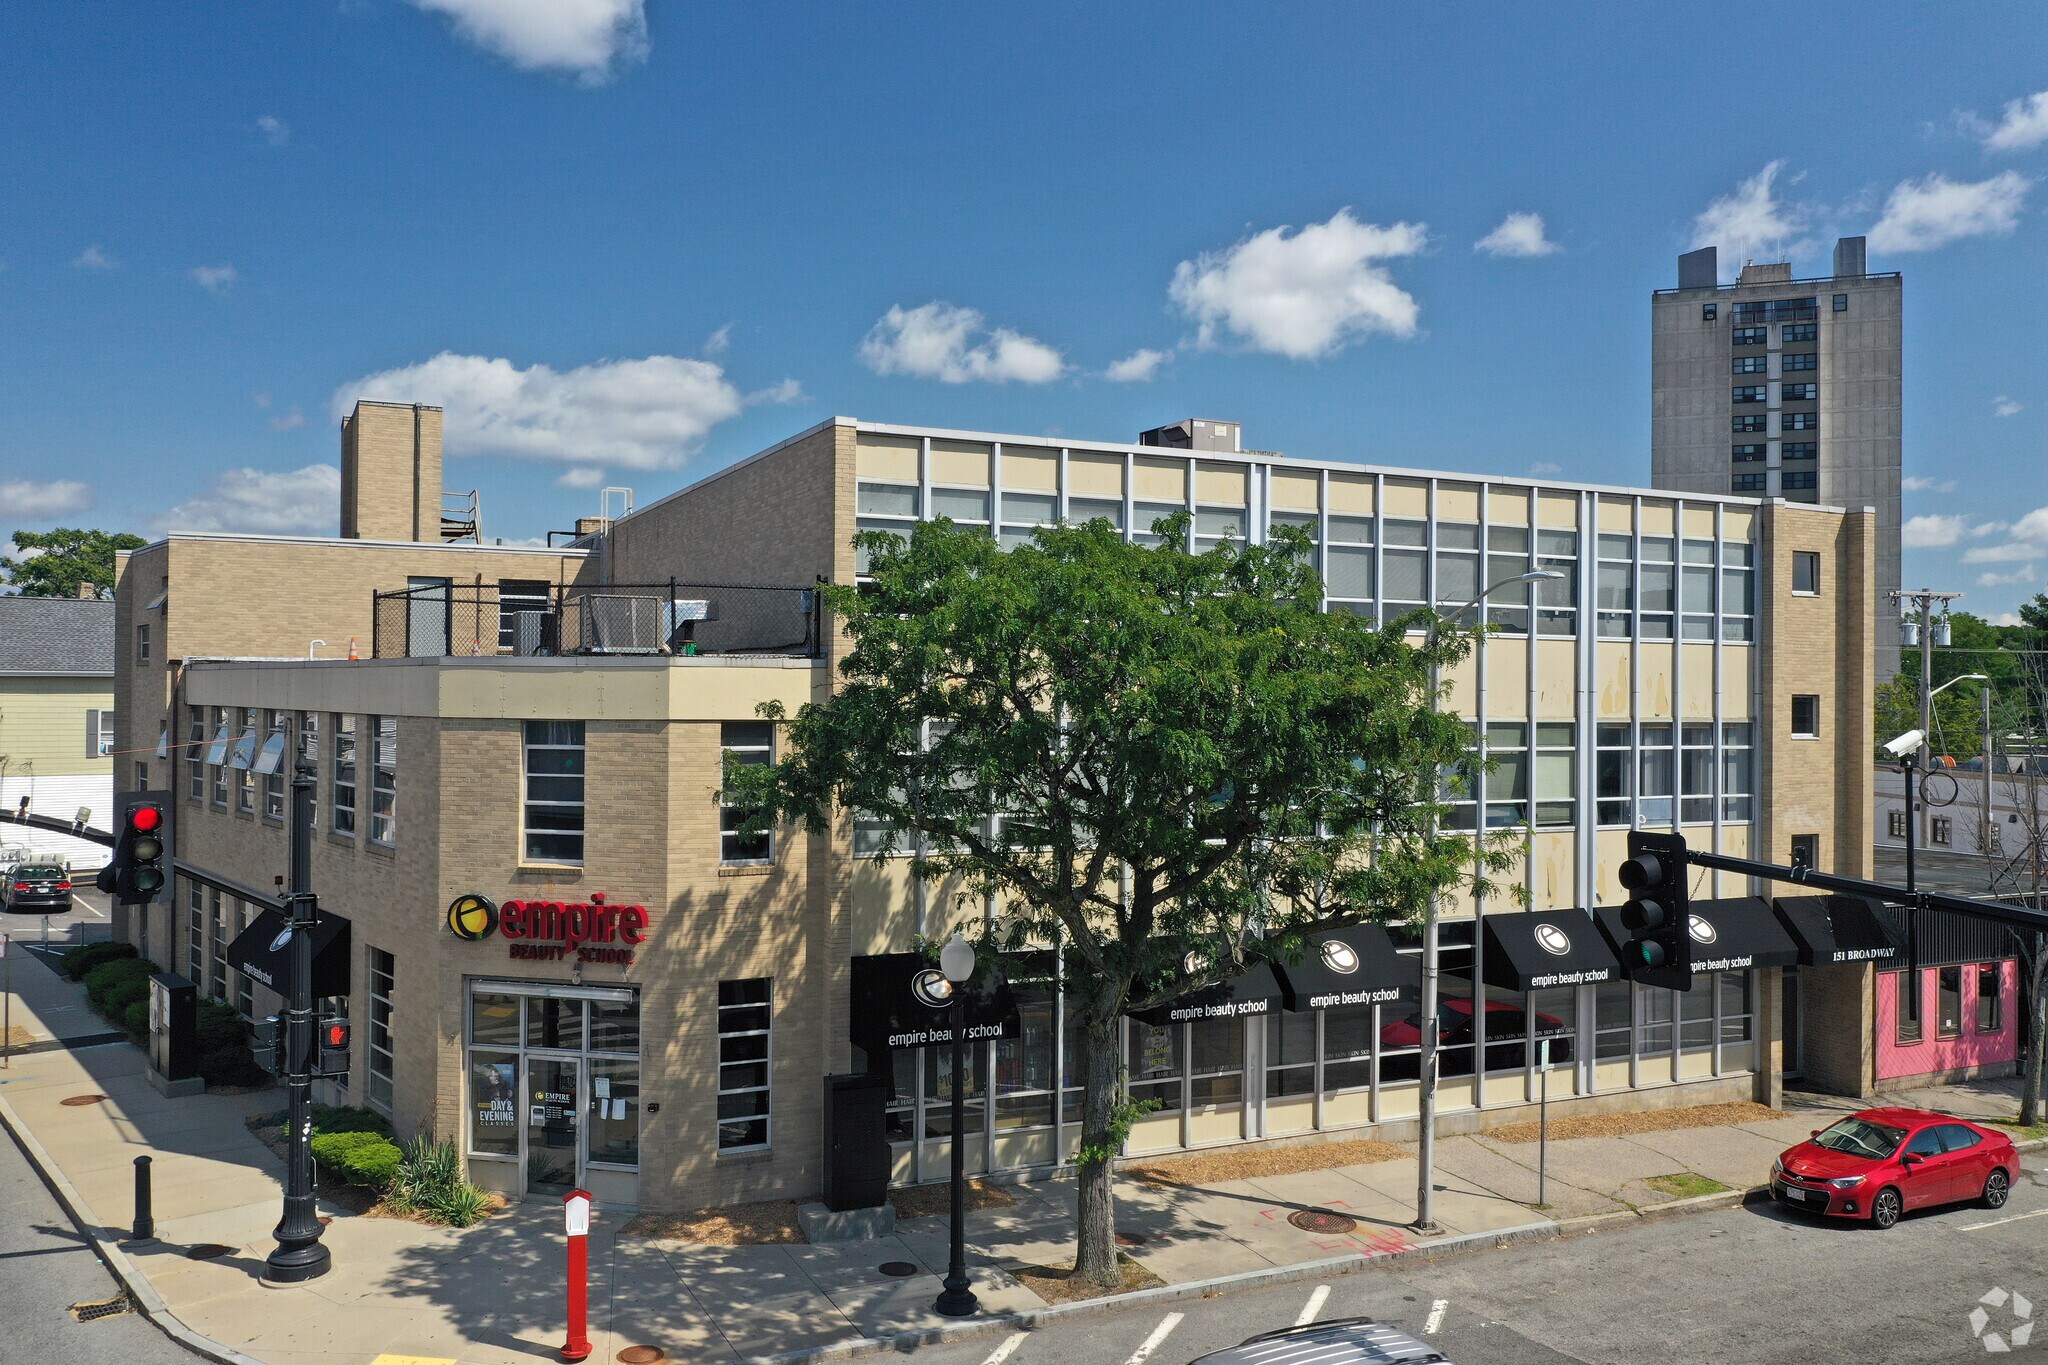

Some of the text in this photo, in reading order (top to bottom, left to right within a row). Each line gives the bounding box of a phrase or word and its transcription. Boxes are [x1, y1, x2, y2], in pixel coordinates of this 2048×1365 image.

[500, 892, 649, 954] empire
[509, 944, 636, 965] BEAUTY SCHOOL
[1690, 954, 1752, 974] pire beauty school
[1832, 948, 1895, 962] 151 BROADWAY
[1531, 967, 1609, 988] empire beauty school
[1310, 986, 1399, 1009] empire beauty school
[1170, 998, 1268, 1021] empire beauty school
[888, 1030, 927, 1047] empire
[968, 1021, 1003, 1039] school
[1149, 1026, 1165, 1035] YOU
[1144, 1046, 1171, 1057] BELONG
[1148, 1058, 1168, 1066] HERE
[545, 1092, 571, 1101] EMPIRE
[479, 1110, 514, 1121] EVENING
